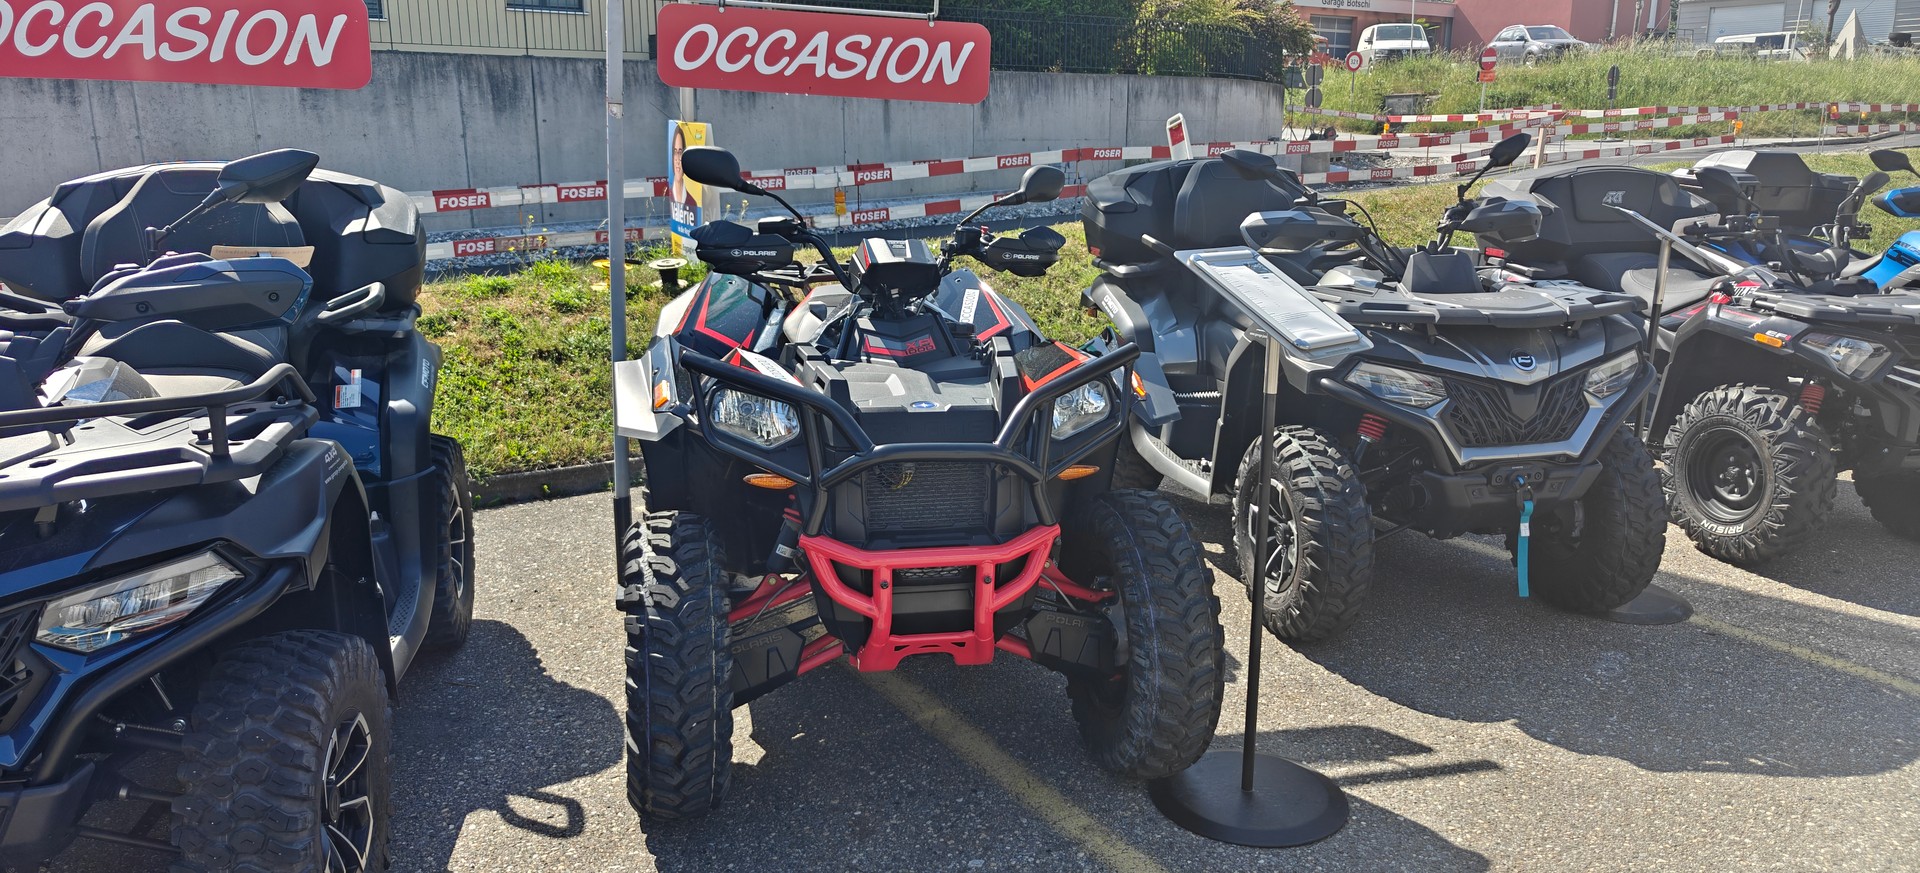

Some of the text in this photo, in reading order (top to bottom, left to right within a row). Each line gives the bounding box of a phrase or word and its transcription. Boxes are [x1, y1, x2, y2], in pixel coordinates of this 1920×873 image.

[0, 2, 347, 67] CCASION
[673, 23, 976, 86] OCCASION
[1093, 149, 1121, 158] FOSER
[1288, 145, 1309, 153] FOSER
[1000, 156, 1029, 167] FOSER
[1457, 162, 1475, 170] FOSER
[857, 170, 890, 182] FOSER
[1371, 170, 1391, 178] FOSER
[750, 178, 783, 189] OSER
[561, 187, 604, 199] FOSER
[439, 194, 487, 208] FOSER
[854, 210, 887, 223] FOSER
[1701, 519, 1744, 534] ARISUN
